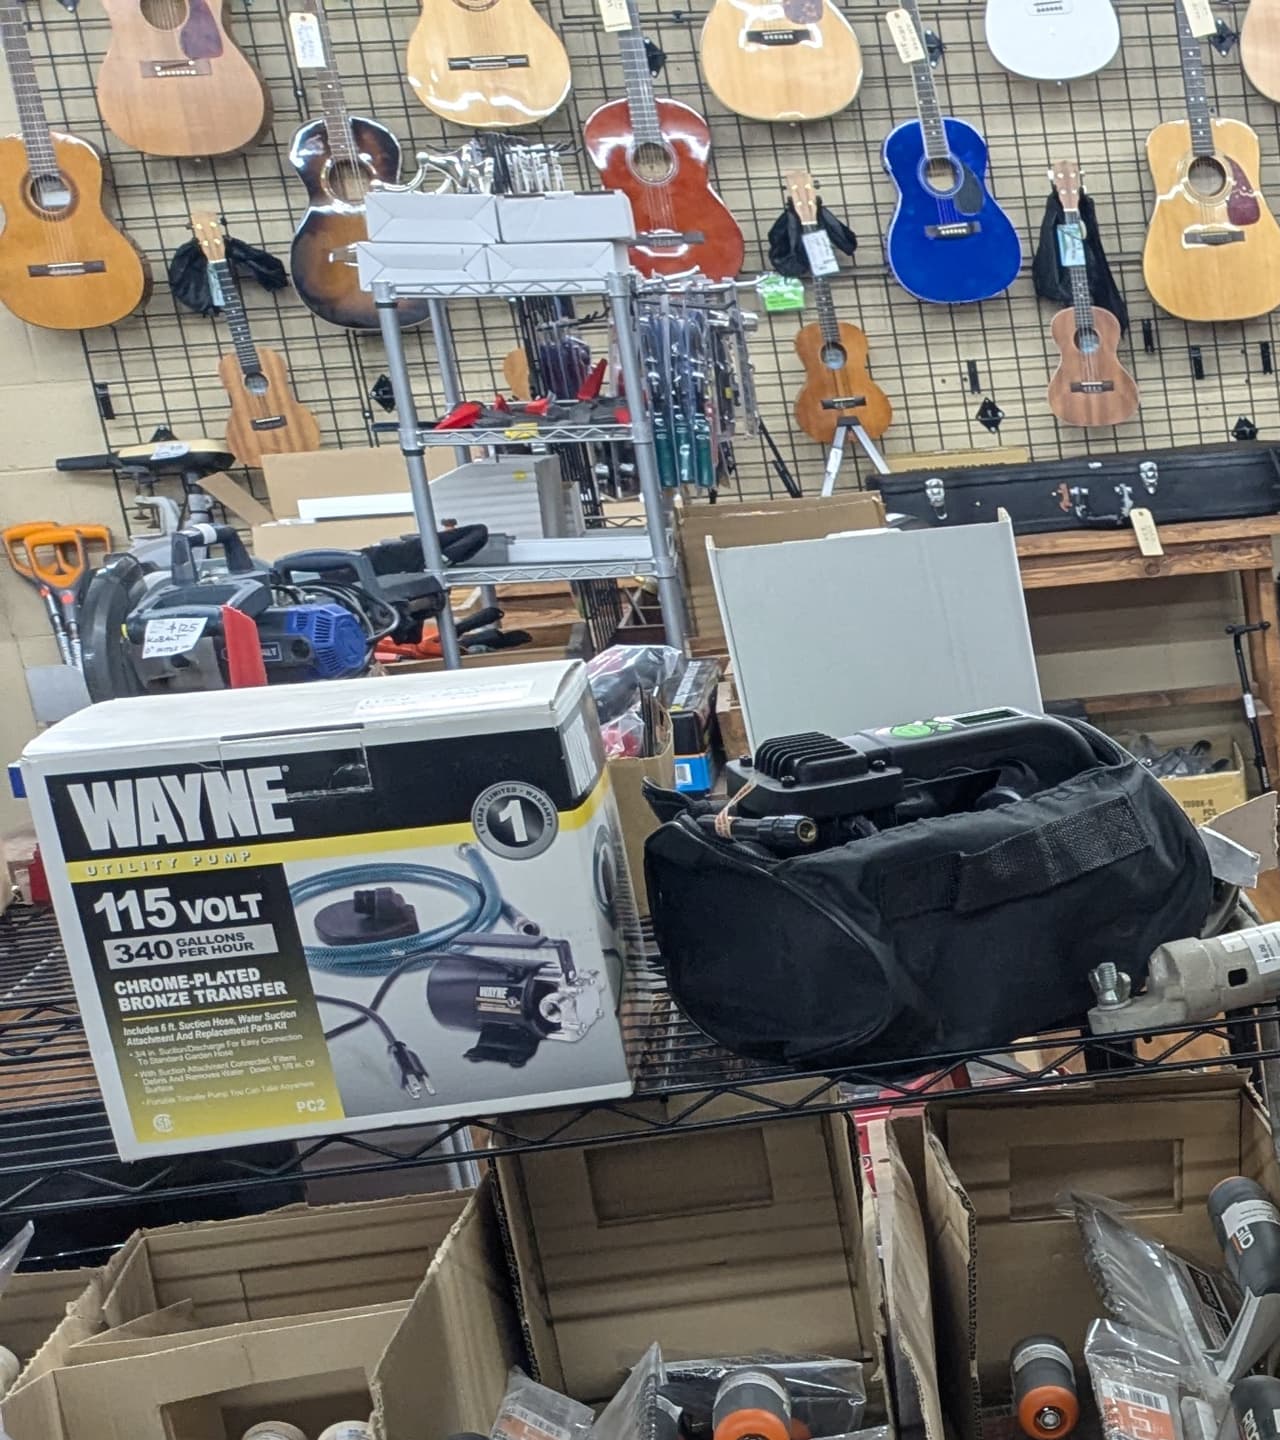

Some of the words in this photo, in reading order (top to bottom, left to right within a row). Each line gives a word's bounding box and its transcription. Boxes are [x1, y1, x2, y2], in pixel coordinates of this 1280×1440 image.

[67, 765, 295, 851] WAYNE
[87, 857, 179, 877] UTILITY
[192, 851, 252, 866] PUMP
[93, 887, 177, 933] 115
[180, 893, 263, 925] VOLT
[113, 939, 173, 964] 340
[175, 932, 245, 948] GALLONS
[178, 946, 207, 959] PER
[211, 941, 255, 955] HOUR
[114, 967, 261, 996] CHROME-PLATED
[118, 992, 192, 1012] BRONZE
[194, 981, 289, 1005] TRANSFER
[296, 1098, 327, 1113] PC2
